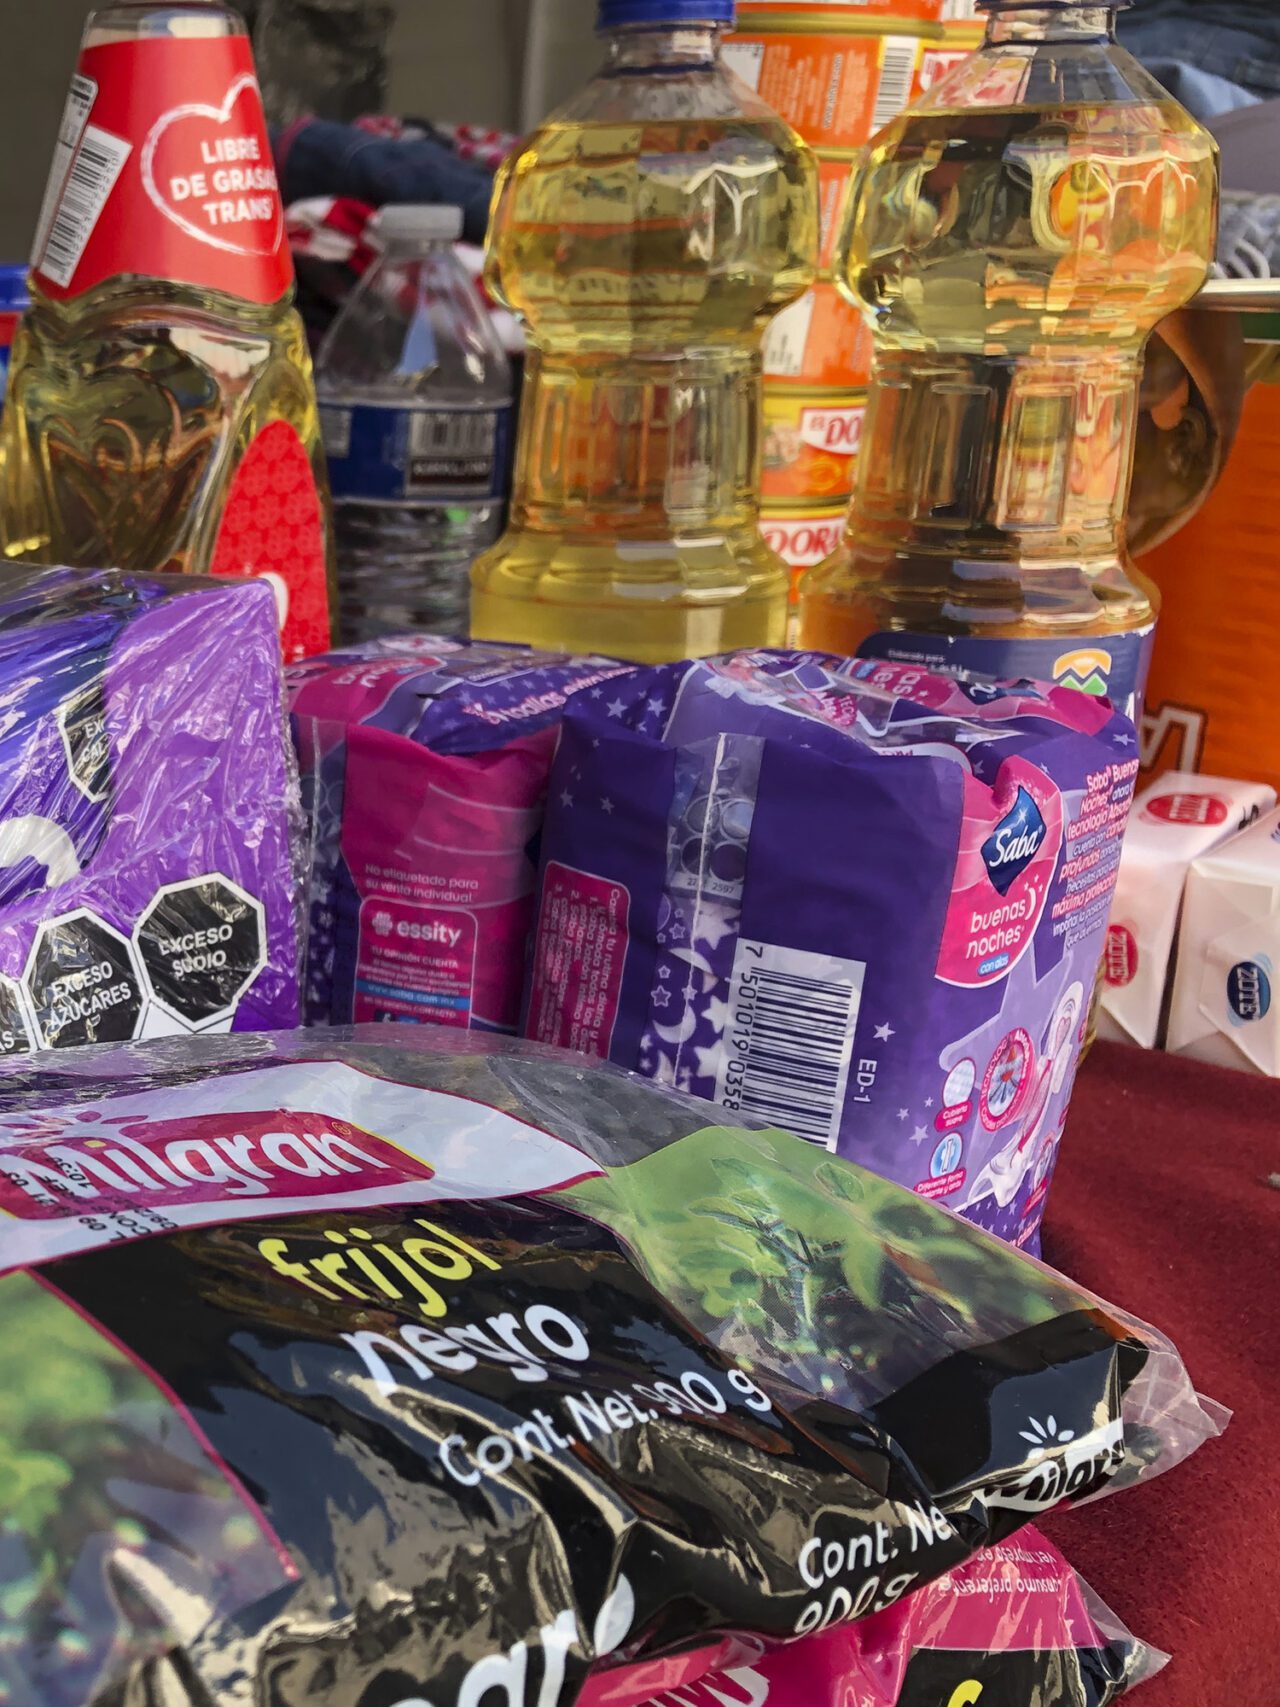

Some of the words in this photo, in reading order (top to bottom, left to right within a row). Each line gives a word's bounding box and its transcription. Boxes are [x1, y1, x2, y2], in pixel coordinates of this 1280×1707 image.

[201, 137, 259, 164] LIBRE
[169, 175, 207, 201] DE
[989, 825, 1046, 869] Saba
[381, 881, 411, 896] venta
[414, 886, 472, 903] individual
[383, 867, 446, 887] etiquetado
[449, 878, 479, 890] para
[397, 920, 463, 948] essity
[971, 898, 1026, 935] buenas
[159, 925, 234, 956] EXCESO
[606, 938, 617, 951] tu
[966, 926, 1022, 960] noches
[52, 961, 114, 999] EXCESO
[600, 953, 612, 989] rutina
[593, 991, 606, 1028] diaria
[1236, 965, 1262, 1021] ZOTE
[733, 972, 759, 1052] 501019
[854, 1058, 877, 1104] ED-1
[257, 1219, 502, 1317] frijol
[339, 1304, 590, 1398] negro
[437, 1407, 577, 1487] Cont.
[565, 1389, 659, 1444] Net.
[727, 1367, 773, 1412] g
[797, 1527, 899, 1591] Cont.
[909, 1499, 954, 1553] Ne
